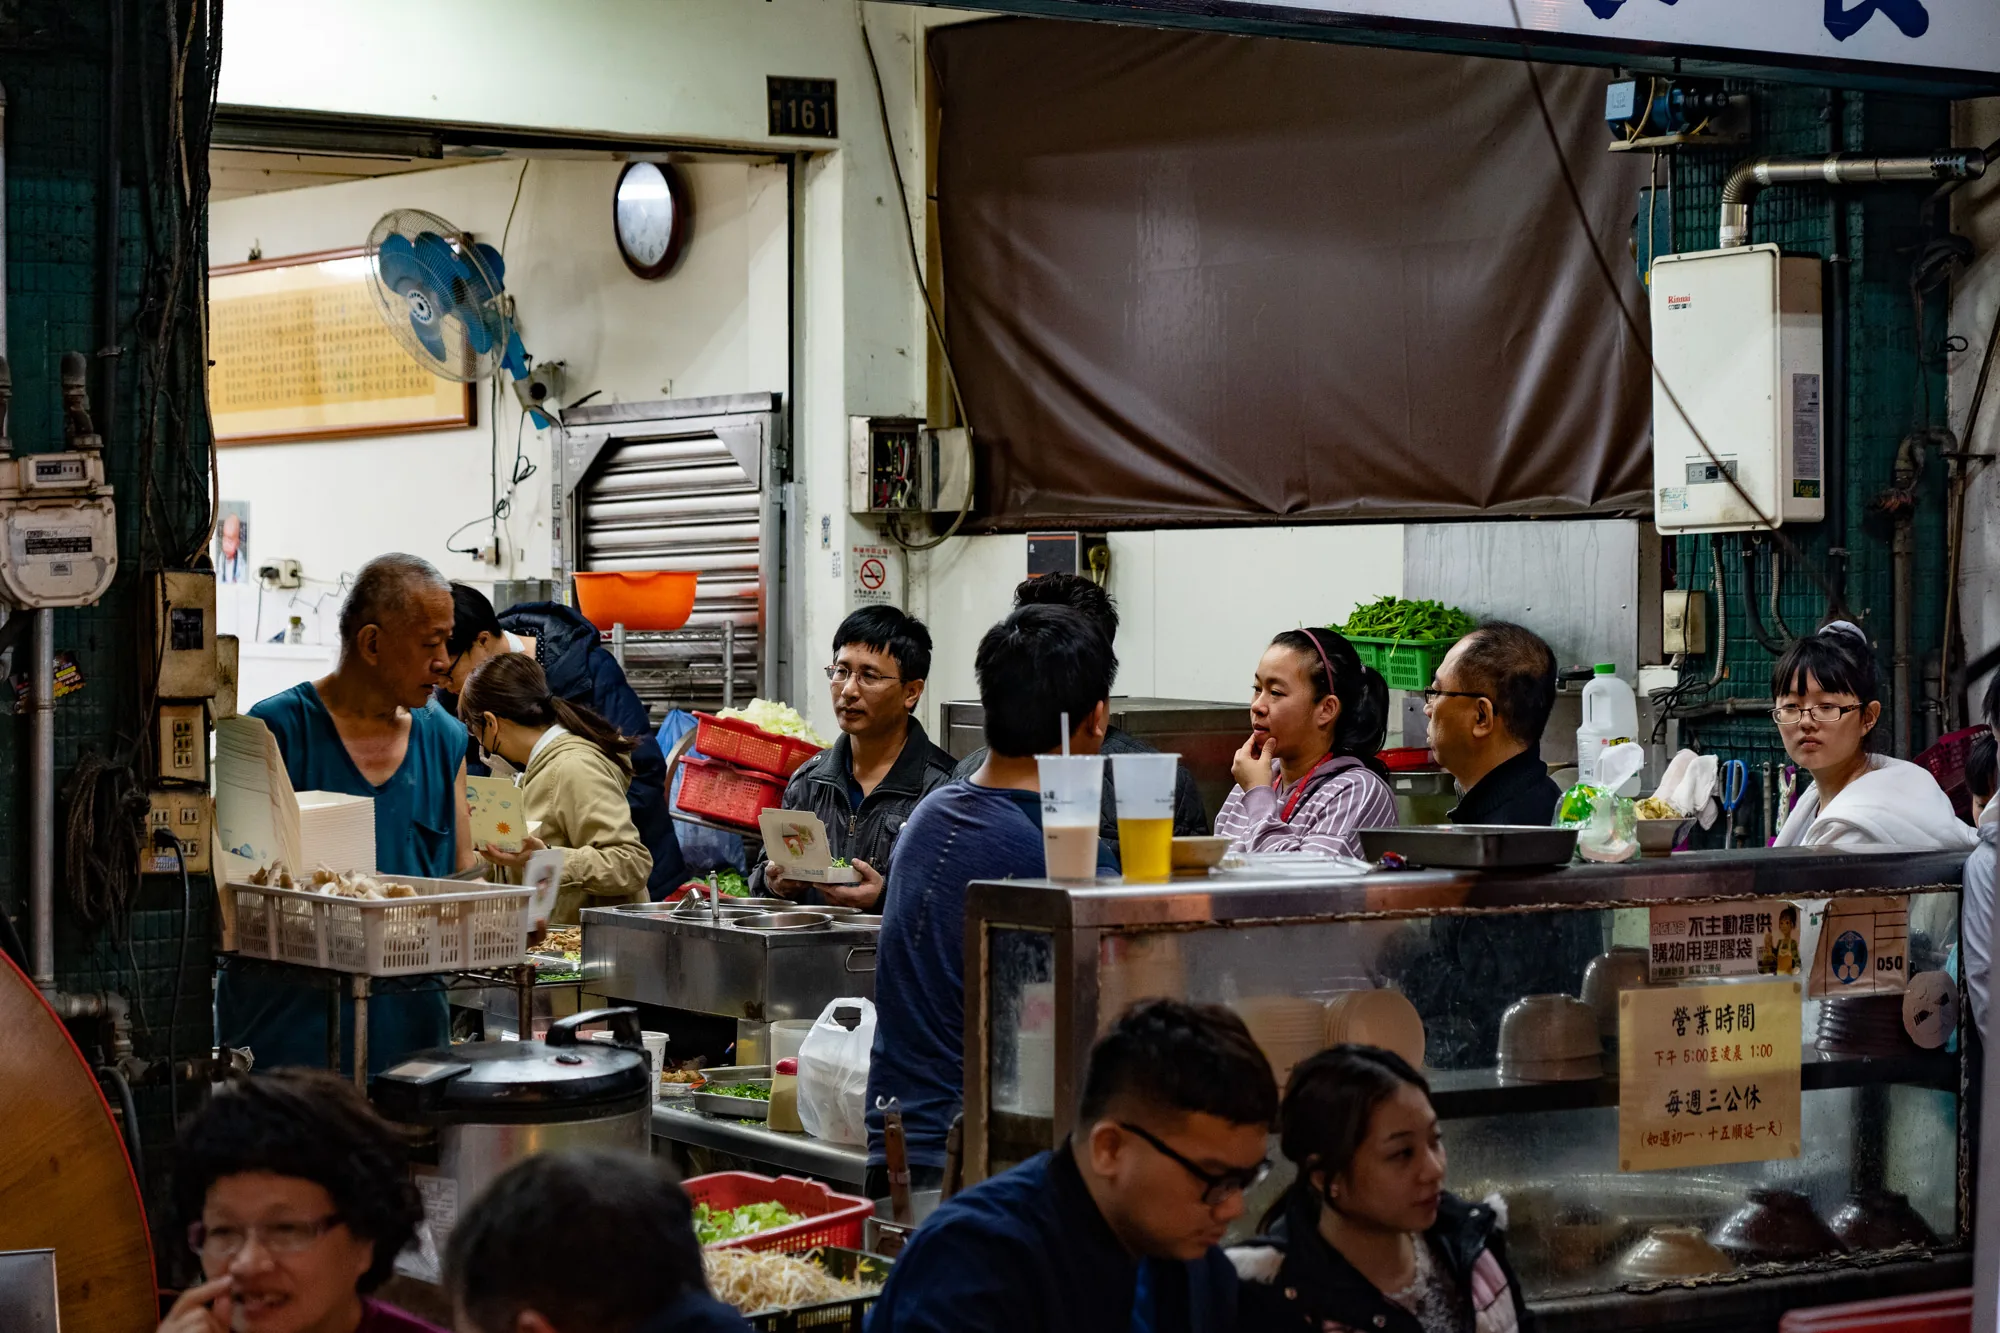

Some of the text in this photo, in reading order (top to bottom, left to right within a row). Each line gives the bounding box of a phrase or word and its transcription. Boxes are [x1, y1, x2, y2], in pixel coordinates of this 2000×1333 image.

[788, 99, 830, 130] 161
[1668, 293, 1691, 304] Rinnai
[1688, 912, 1772, 937] 不主動提供
[1652, 937, 1753, 964] 購物用塑膠袋
[1877, 955, 1903, 971] 050
[1672, 1003, 1755, 1037] 營業時間
[1654, 1043, 1773, 1066] 下午 5:00至凌晨 1:00
[1665, 1084, 1762, 1118] 每週三公休
